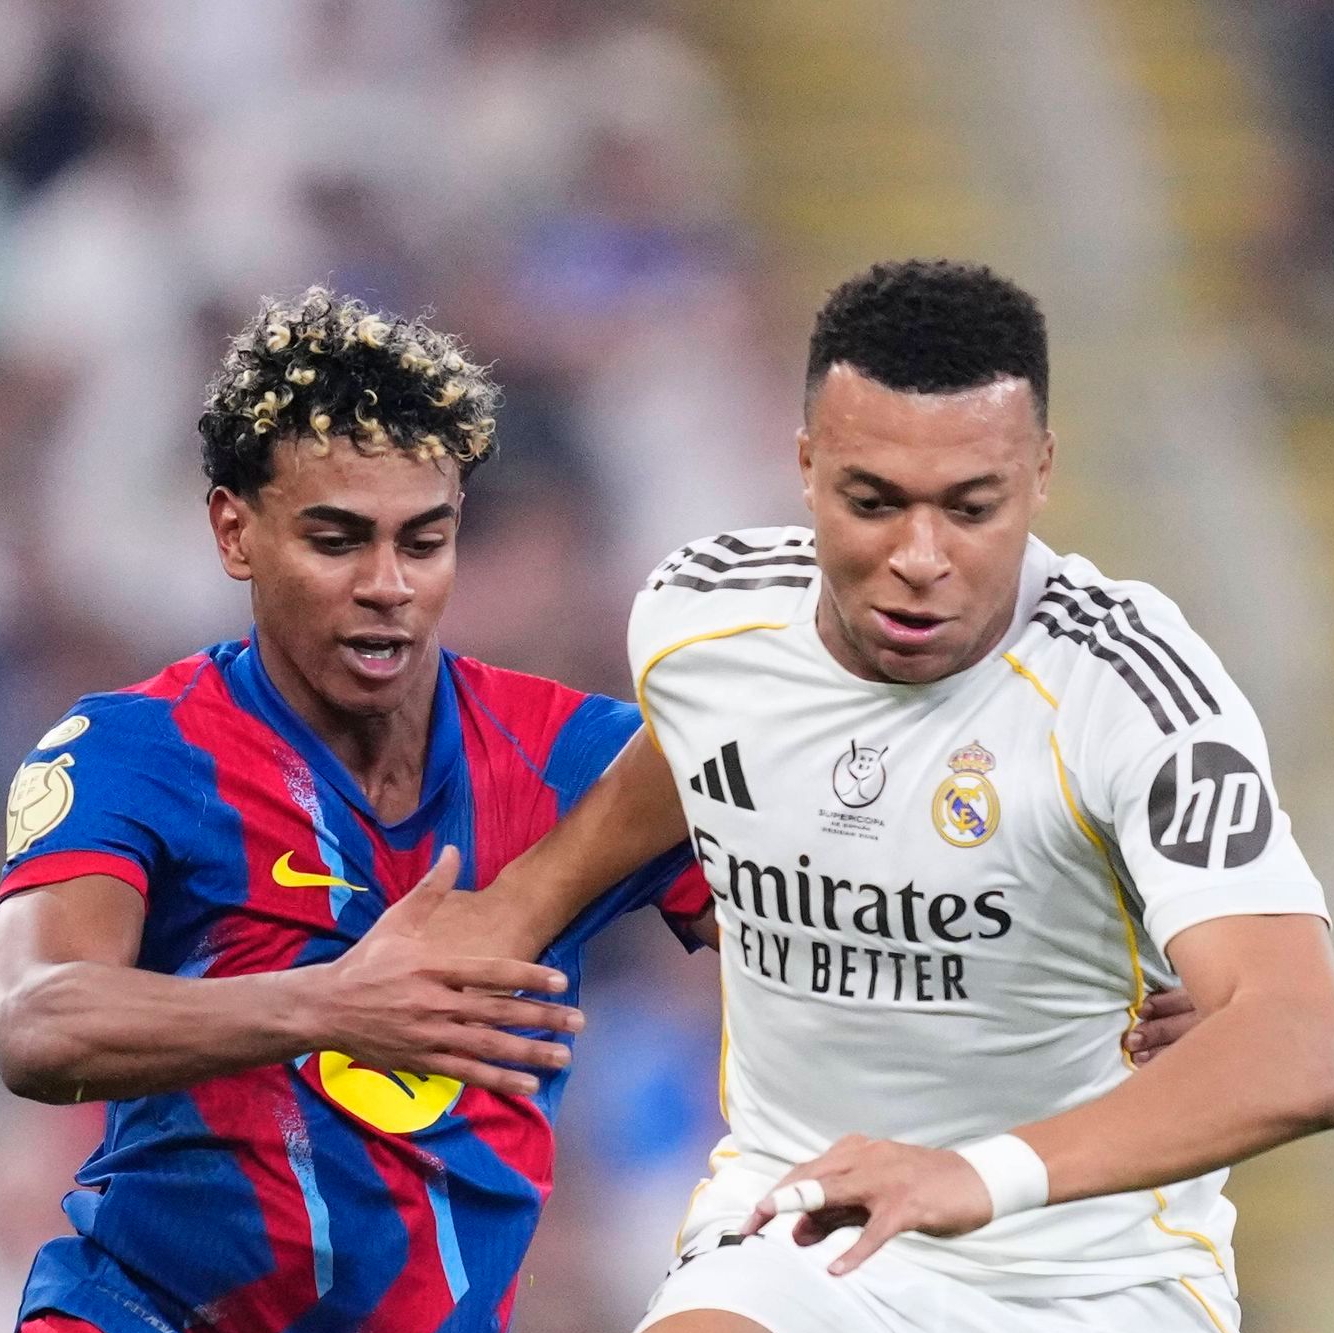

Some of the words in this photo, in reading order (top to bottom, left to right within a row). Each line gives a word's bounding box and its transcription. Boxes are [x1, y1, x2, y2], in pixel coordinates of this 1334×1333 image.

[1159, 742, 1261, 869] hp
[694, 825, 1012, 943] Emirates
[740, 921, 790, 984] FLY
[811, 941, 969, 1001] BETTER
